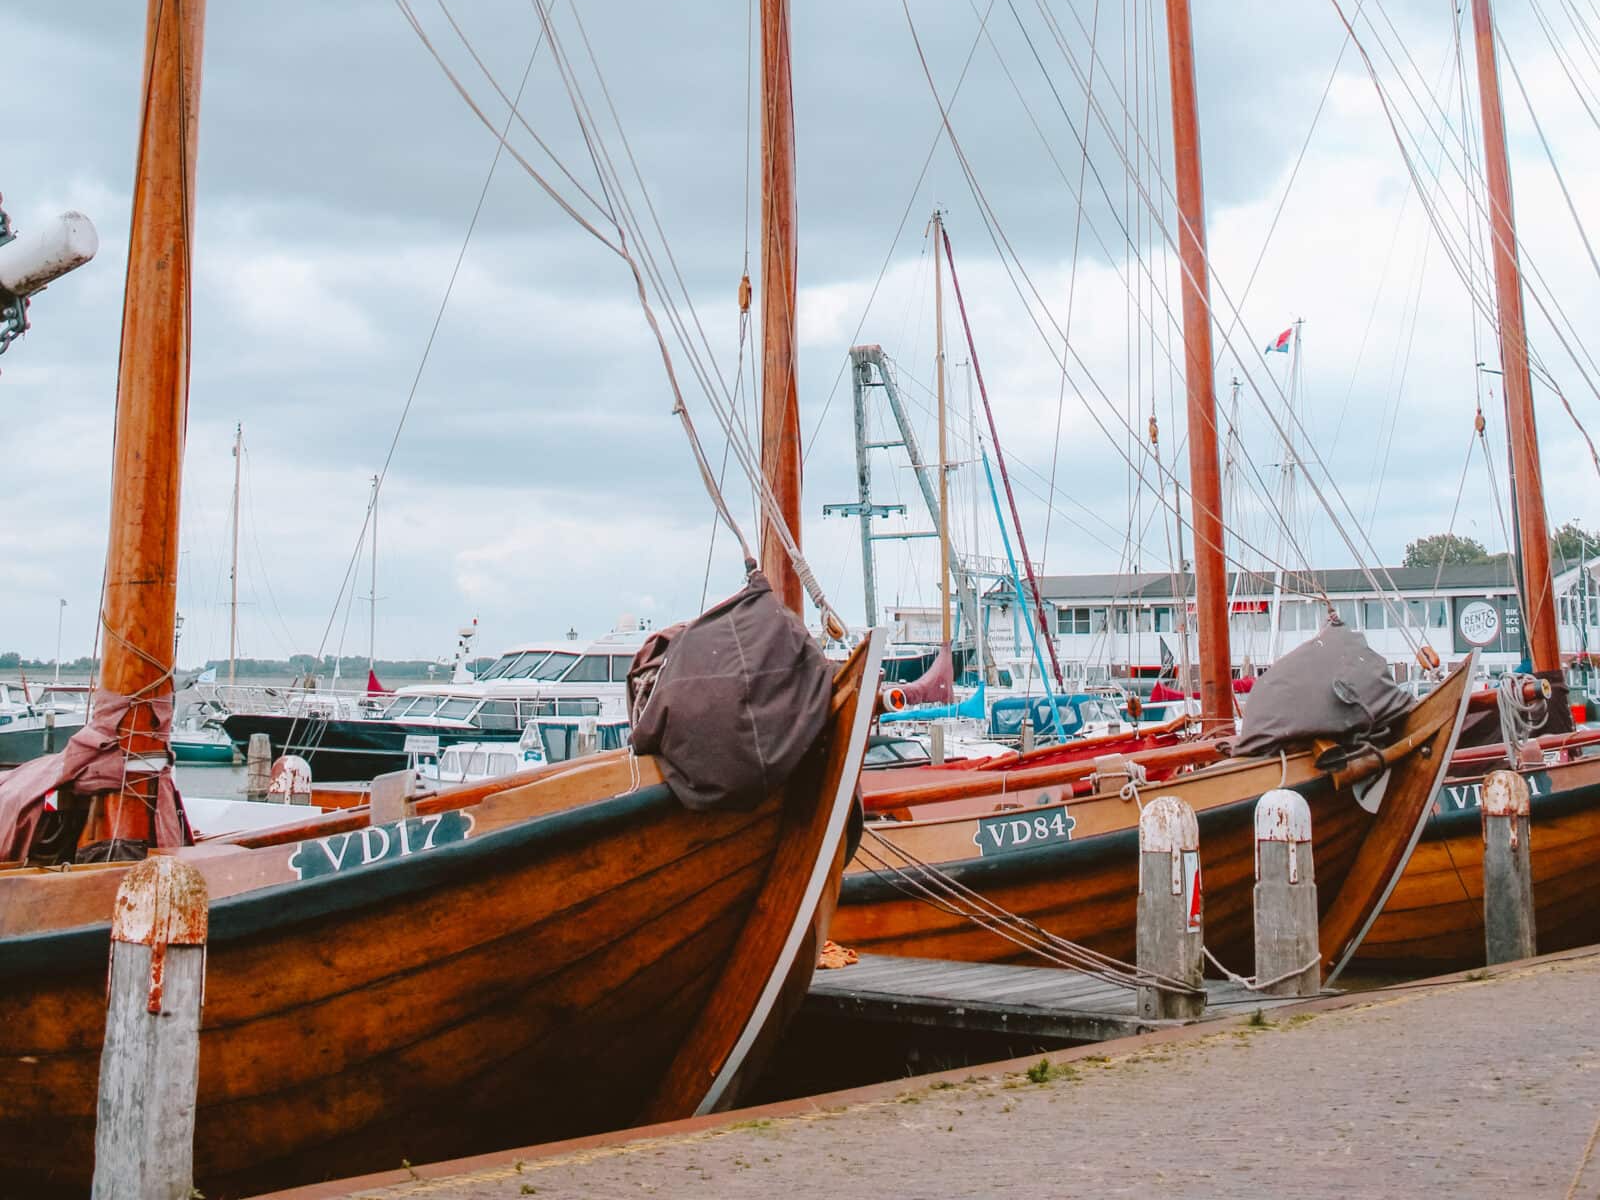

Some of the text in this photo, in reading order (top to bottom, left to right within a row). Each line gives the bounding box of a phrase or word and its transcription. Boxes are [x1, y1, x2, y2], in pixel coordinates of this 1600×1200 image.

[1464, 611, 1486, 625] RENT
[1504, 608, 1519, 616] BIK
[986, 813, 1066, 847] VD84
[317, 814, 443, 871] VD17
